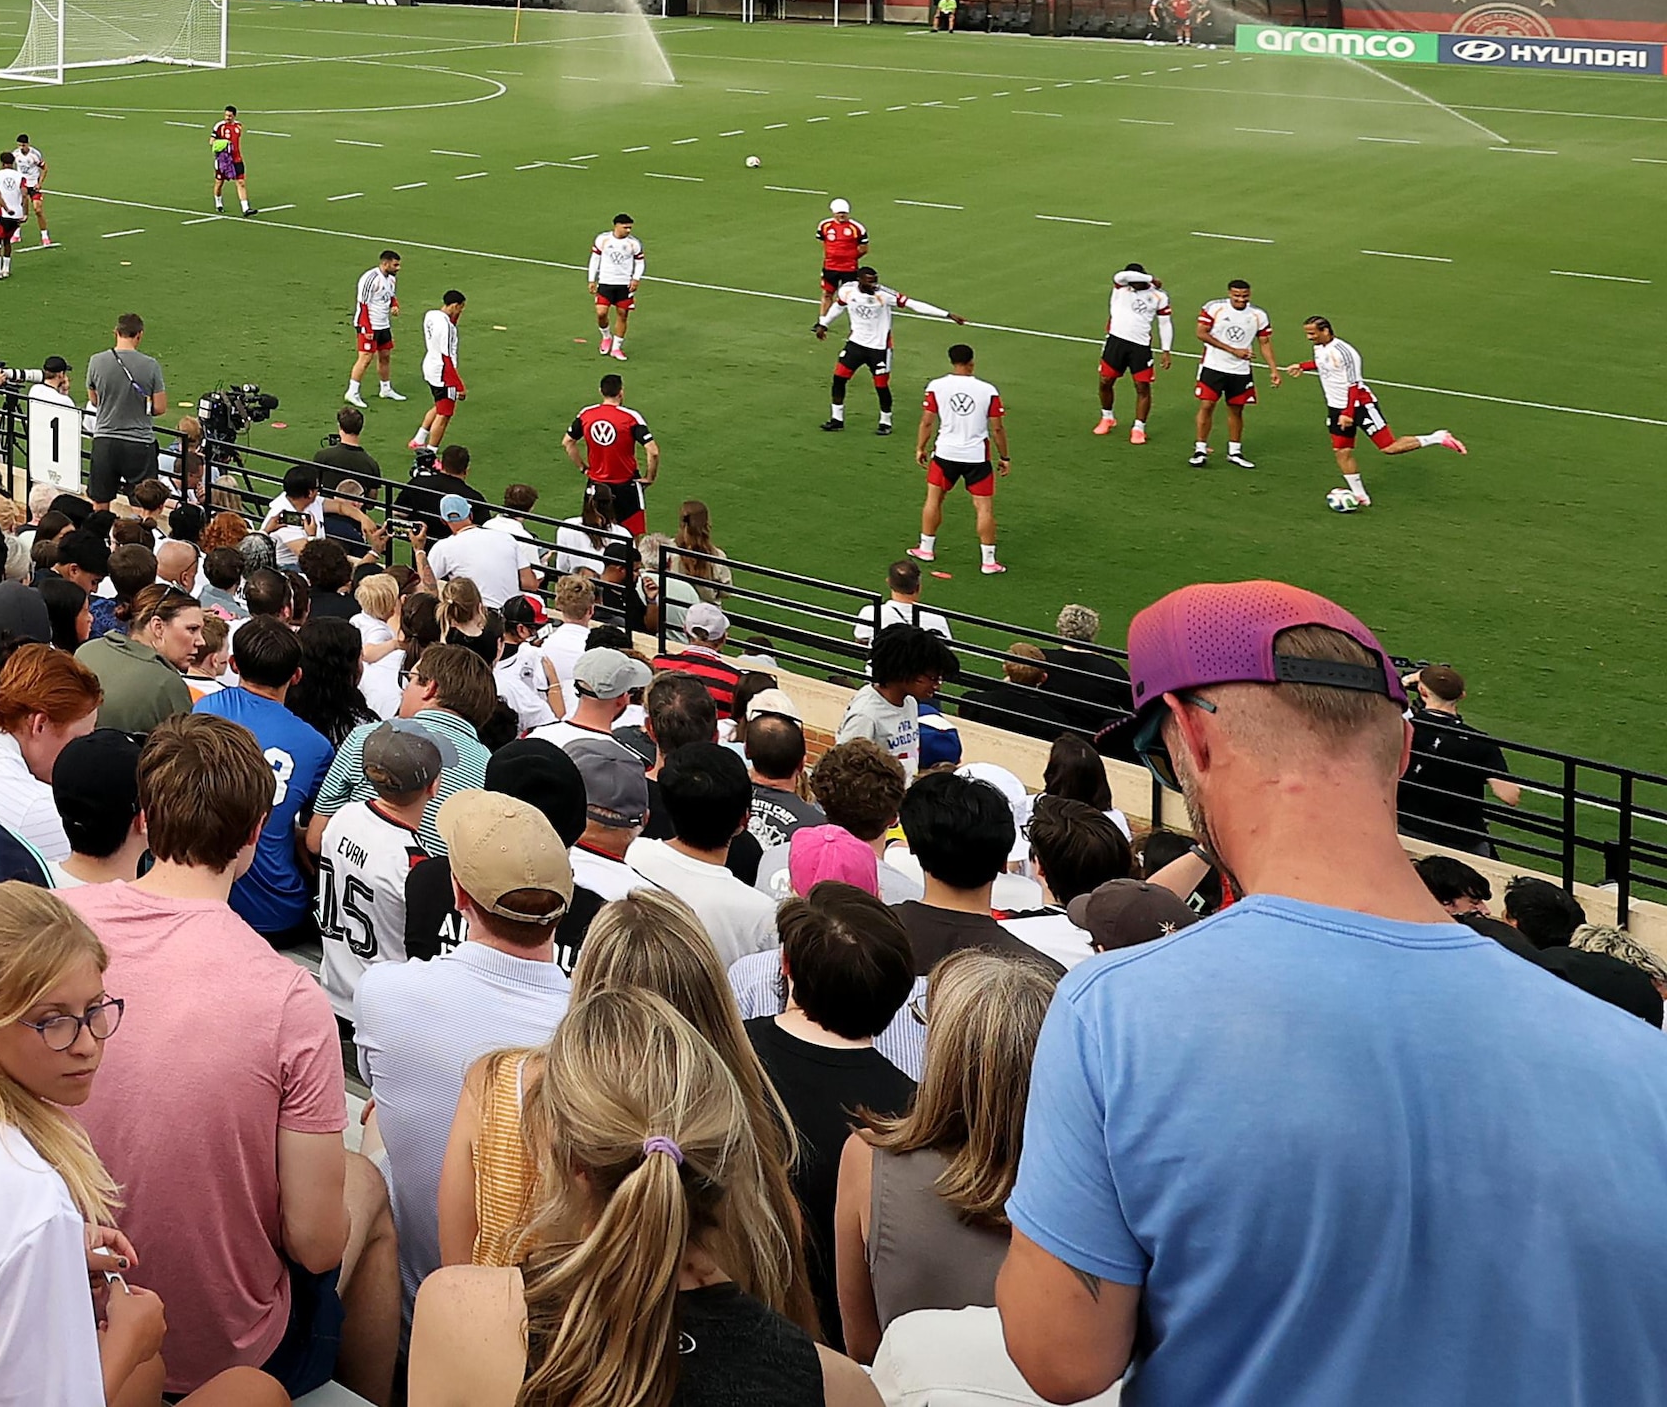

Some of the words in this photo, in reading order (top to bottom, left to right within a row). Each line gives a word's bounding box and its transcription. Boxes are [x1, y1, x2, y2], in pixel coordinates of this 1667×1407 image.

[1255, 29, 1416, 58] aramco
[1510, 44, 1648, 68] HYUNDAI
[50, 416, 59, 463] 1
[337, 836, 369, 870] EVAN
[320, 856, 379, 960] 15
